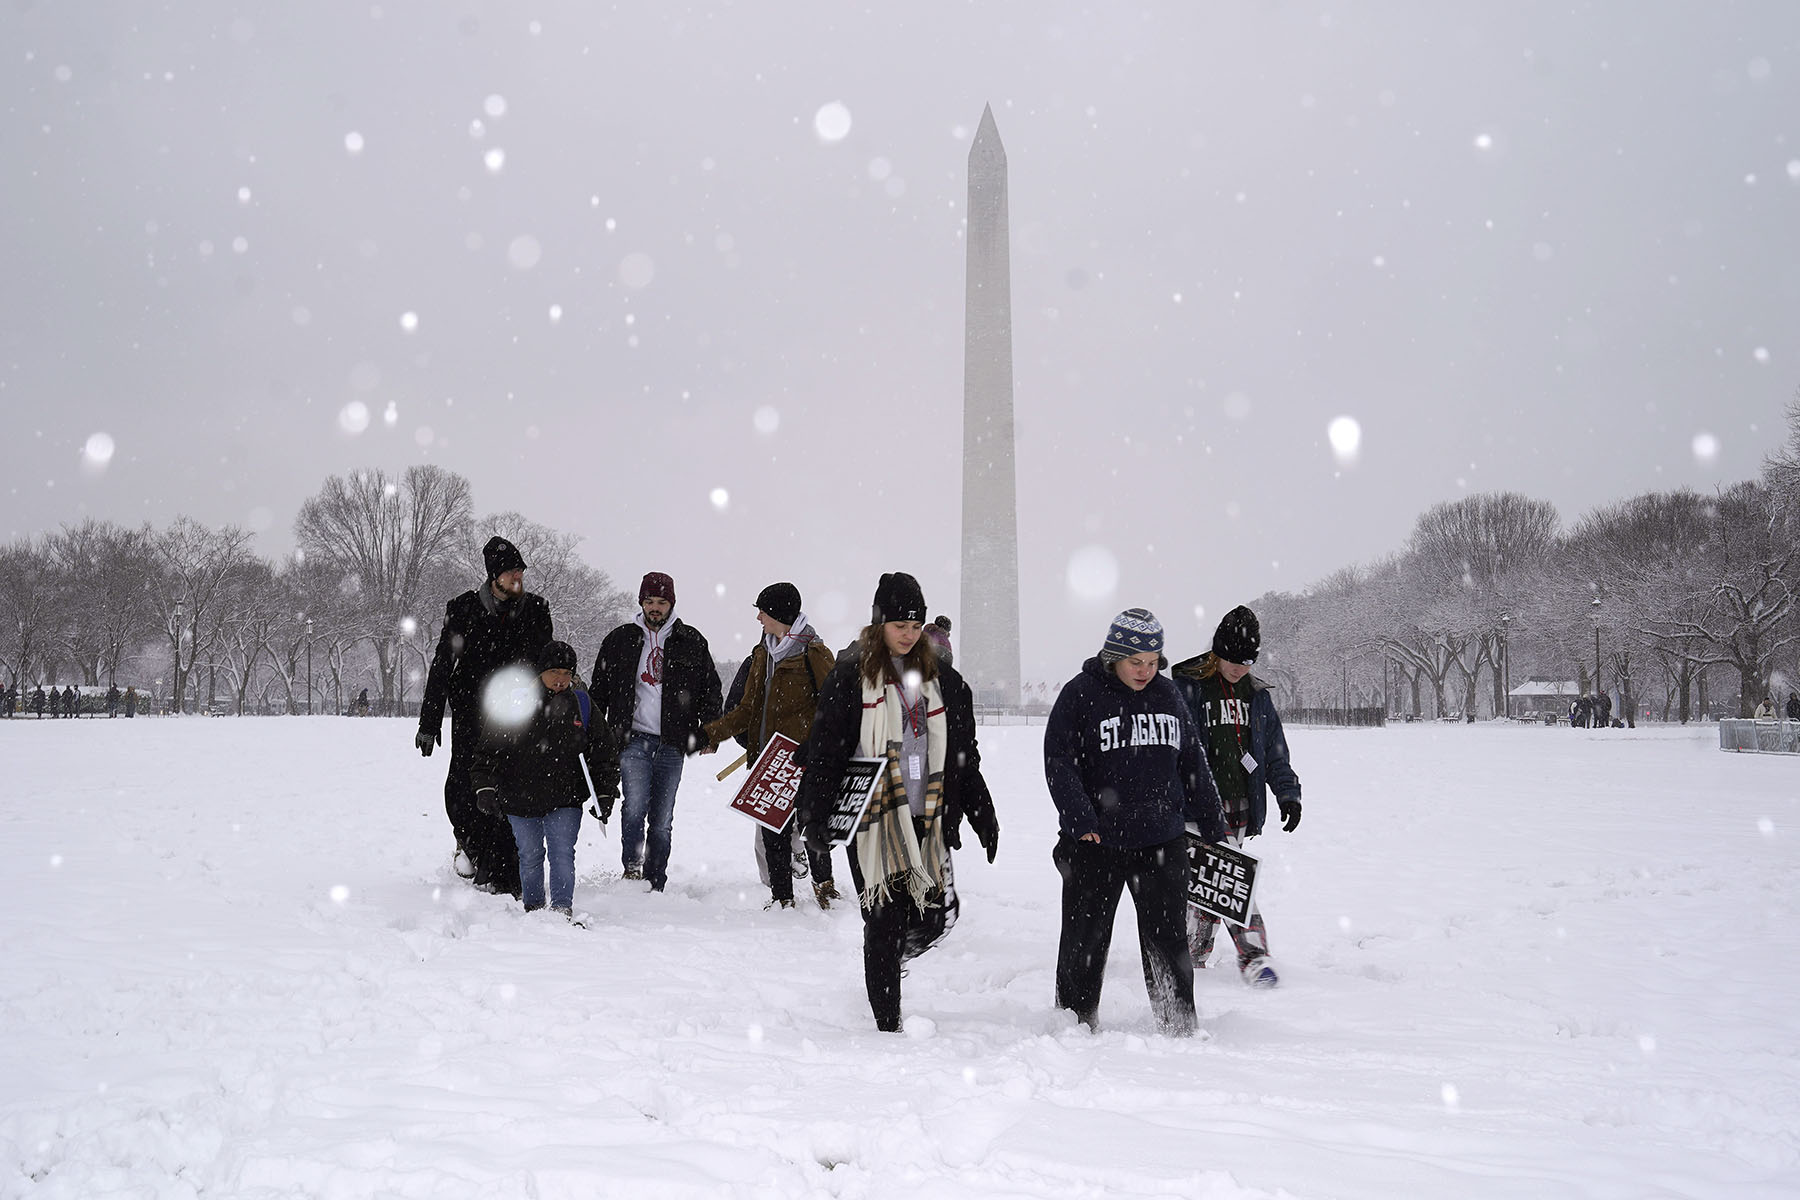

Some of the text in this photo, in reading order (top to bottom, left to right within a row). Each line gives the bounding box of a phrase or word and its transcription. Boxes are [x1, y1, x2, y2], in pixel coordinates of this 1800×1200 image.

[1220, 699, 1250, 727] AGAT
[1100, 716, 1127, 752] ST.
[745, 748, 789, 806] LET THEIR
[850, 776, 873, 791] THE
[834, 792, 868, 813] -LIFE
[1205, 853, 1246, 880] THE
[1187, 880, 1243, 914] RATION
[1190, 865, 1250, 900] -LIFE
